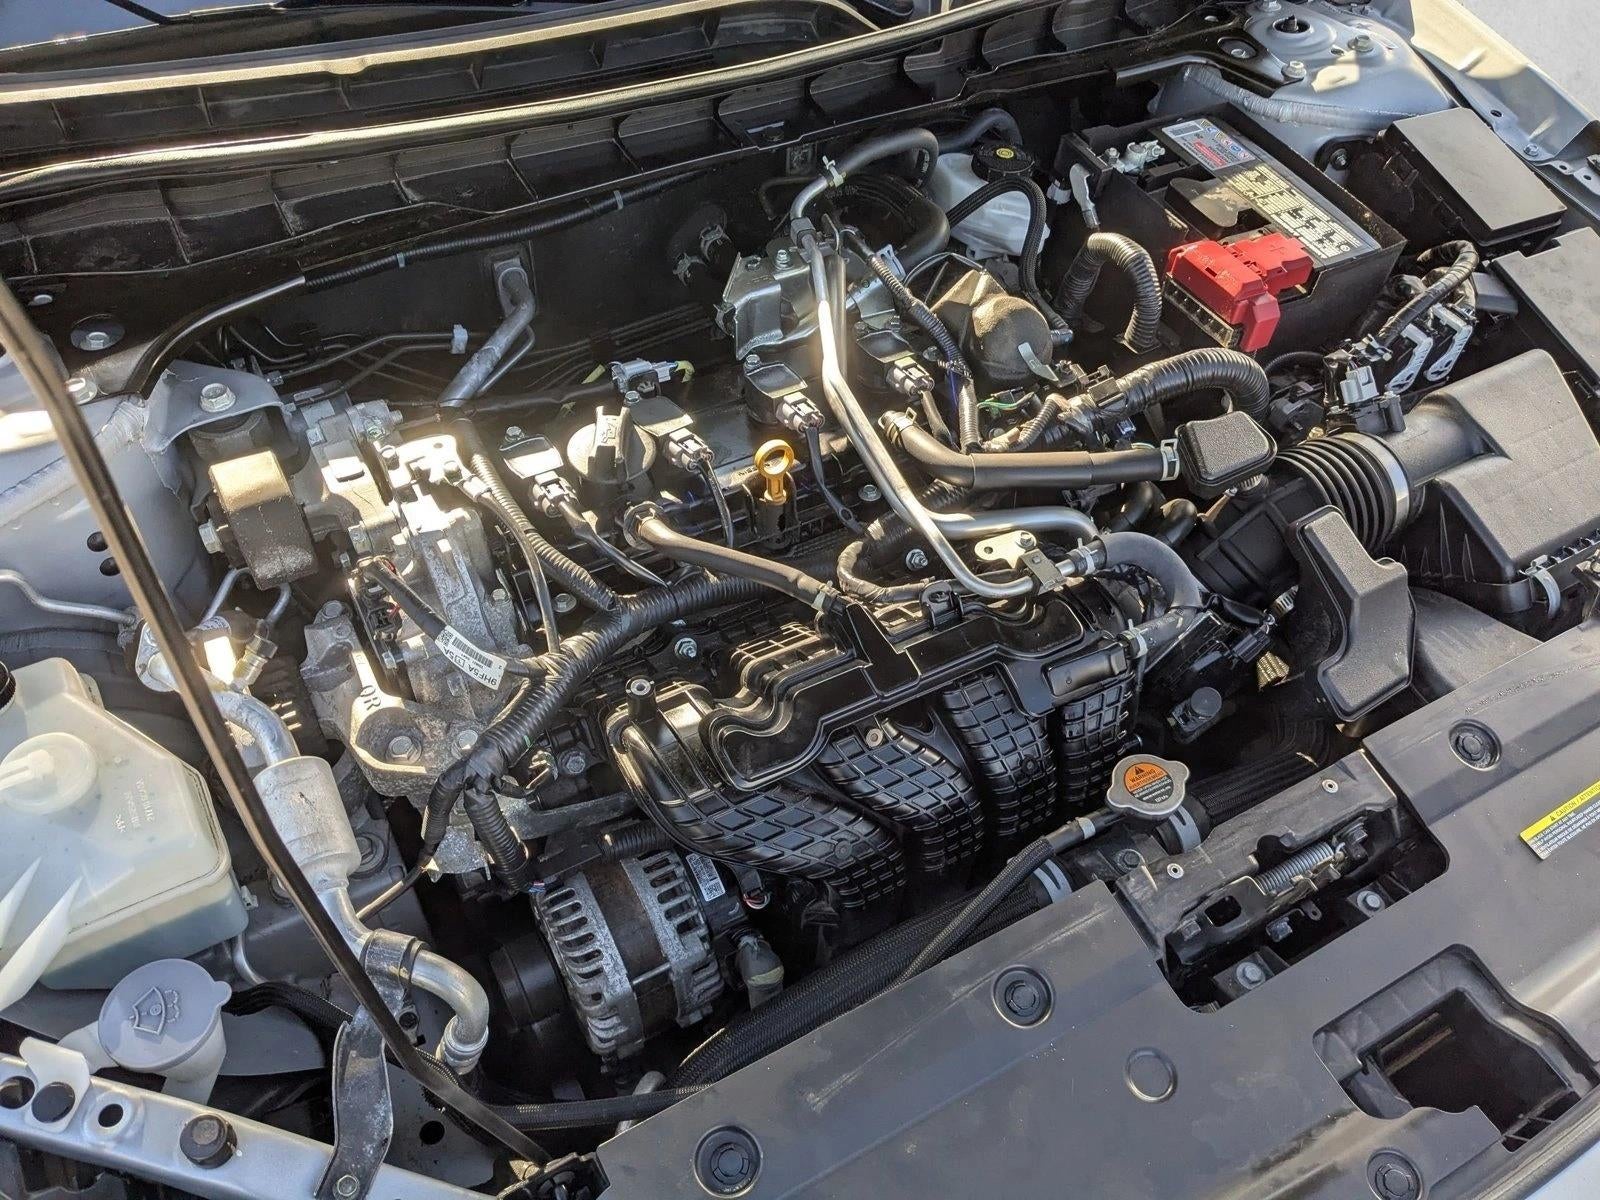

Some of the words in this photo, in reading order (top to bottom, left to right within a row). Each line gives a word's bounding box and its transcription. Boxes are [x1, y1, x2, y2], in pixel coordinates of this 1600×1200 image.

[468, 664, 497, 686] 9HF5A
[1129, 768, 1156, 783] WARNING
[1556, 800, 1577, 816] CAUTION
